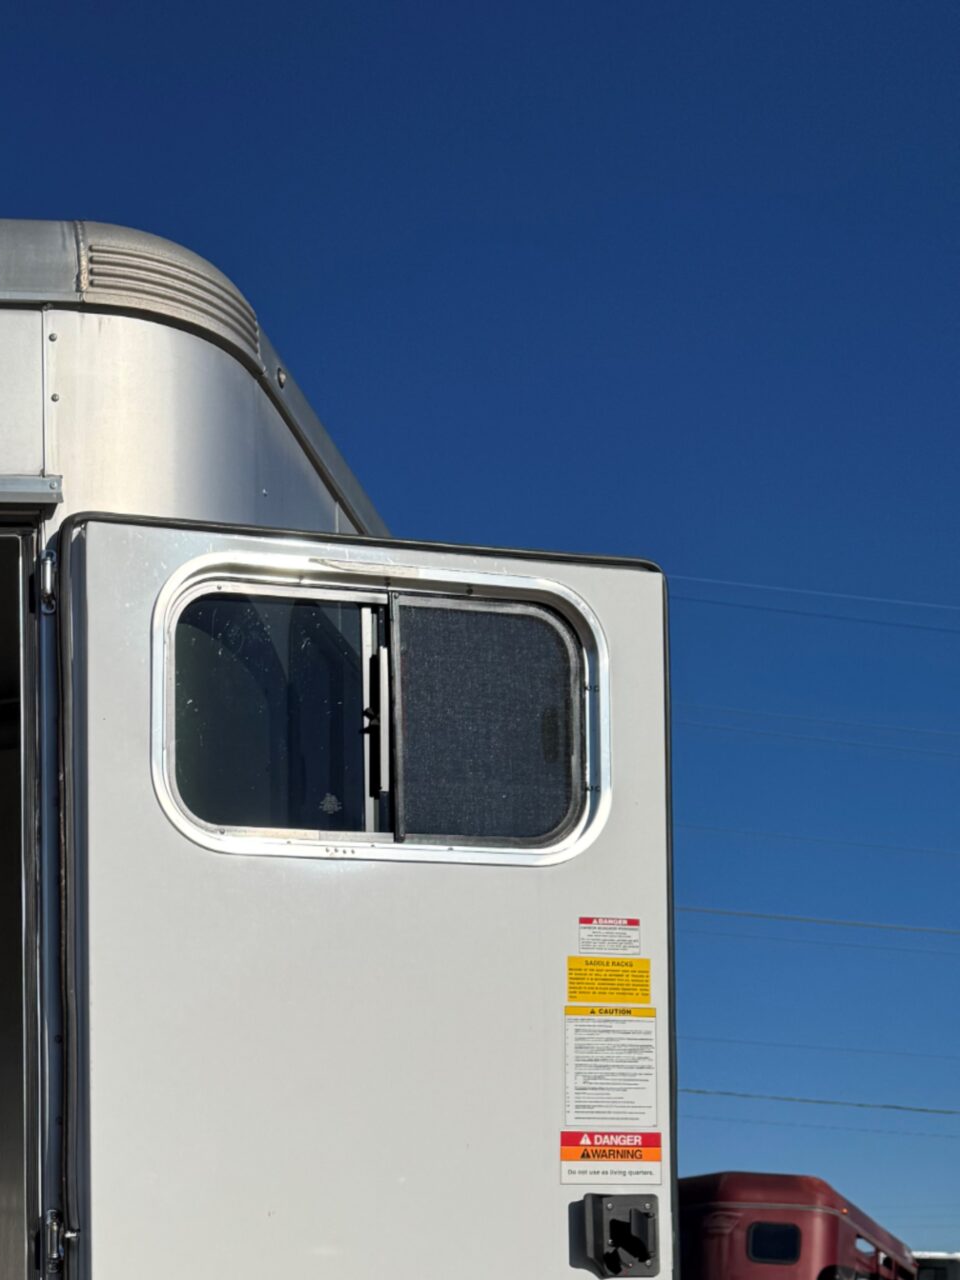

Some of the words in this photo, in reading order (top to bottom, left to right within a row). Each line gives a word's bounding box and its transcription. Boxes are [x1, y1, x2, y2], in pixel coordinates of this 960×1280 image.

[594, 1135, 642, 1146] DANGER
[592, 1149, 643, 1160] WARNING
[610, 1169, 626, 1177] living
